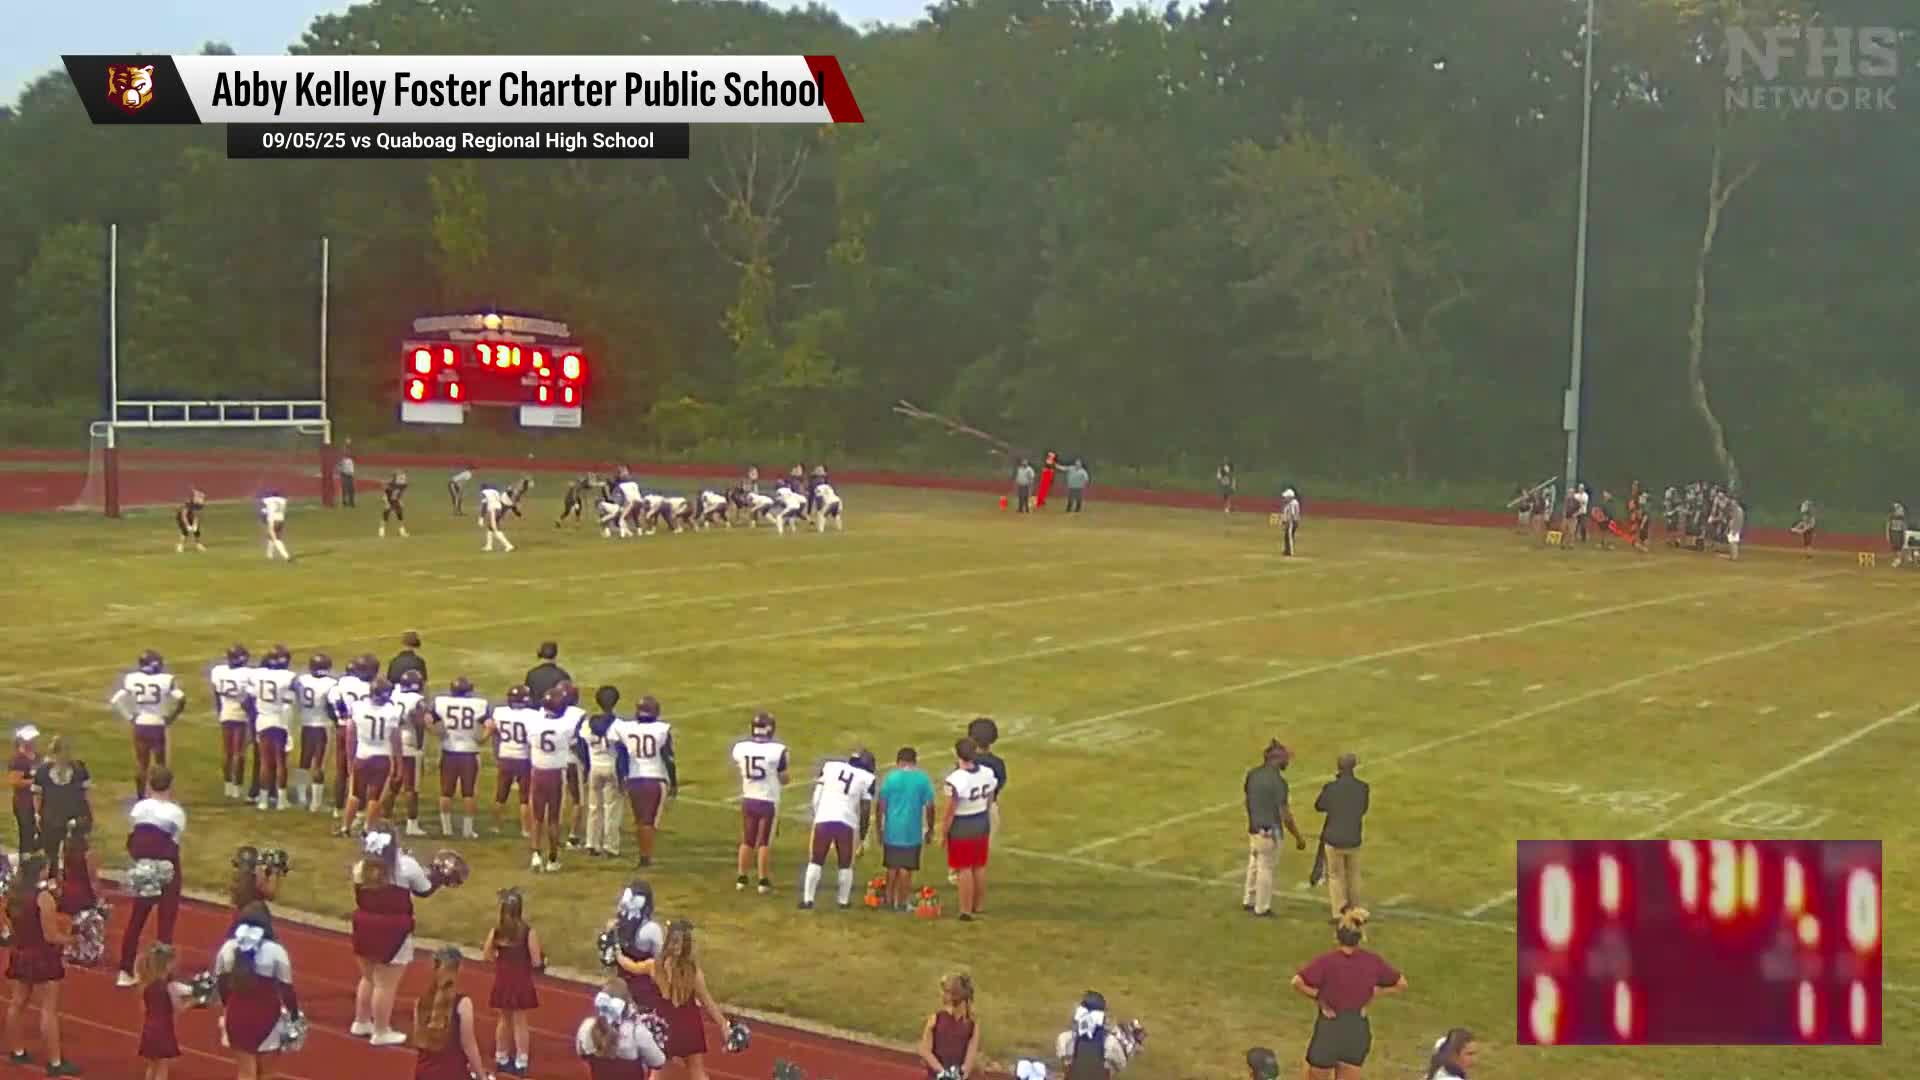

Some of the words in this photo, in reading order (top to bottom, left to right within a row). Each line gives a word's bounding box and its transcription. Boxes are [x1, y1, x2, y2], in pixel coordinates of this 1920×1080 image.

[133, 683, 161, 704] 23
[220, 679, 238, 697] 12
[259, 679, 277, 702] 13
[303, 686, 315, 708] 9
[363, 714, 385, 741] 71
[446, 705, 475, 730] 58
[500, 721, 526, 744] 50
[540, 731, 556, 752] 6
[629, 734, 656, 759] 70
[744, 755, 766, 780] 15
[838, 770, 854, 795] 4
